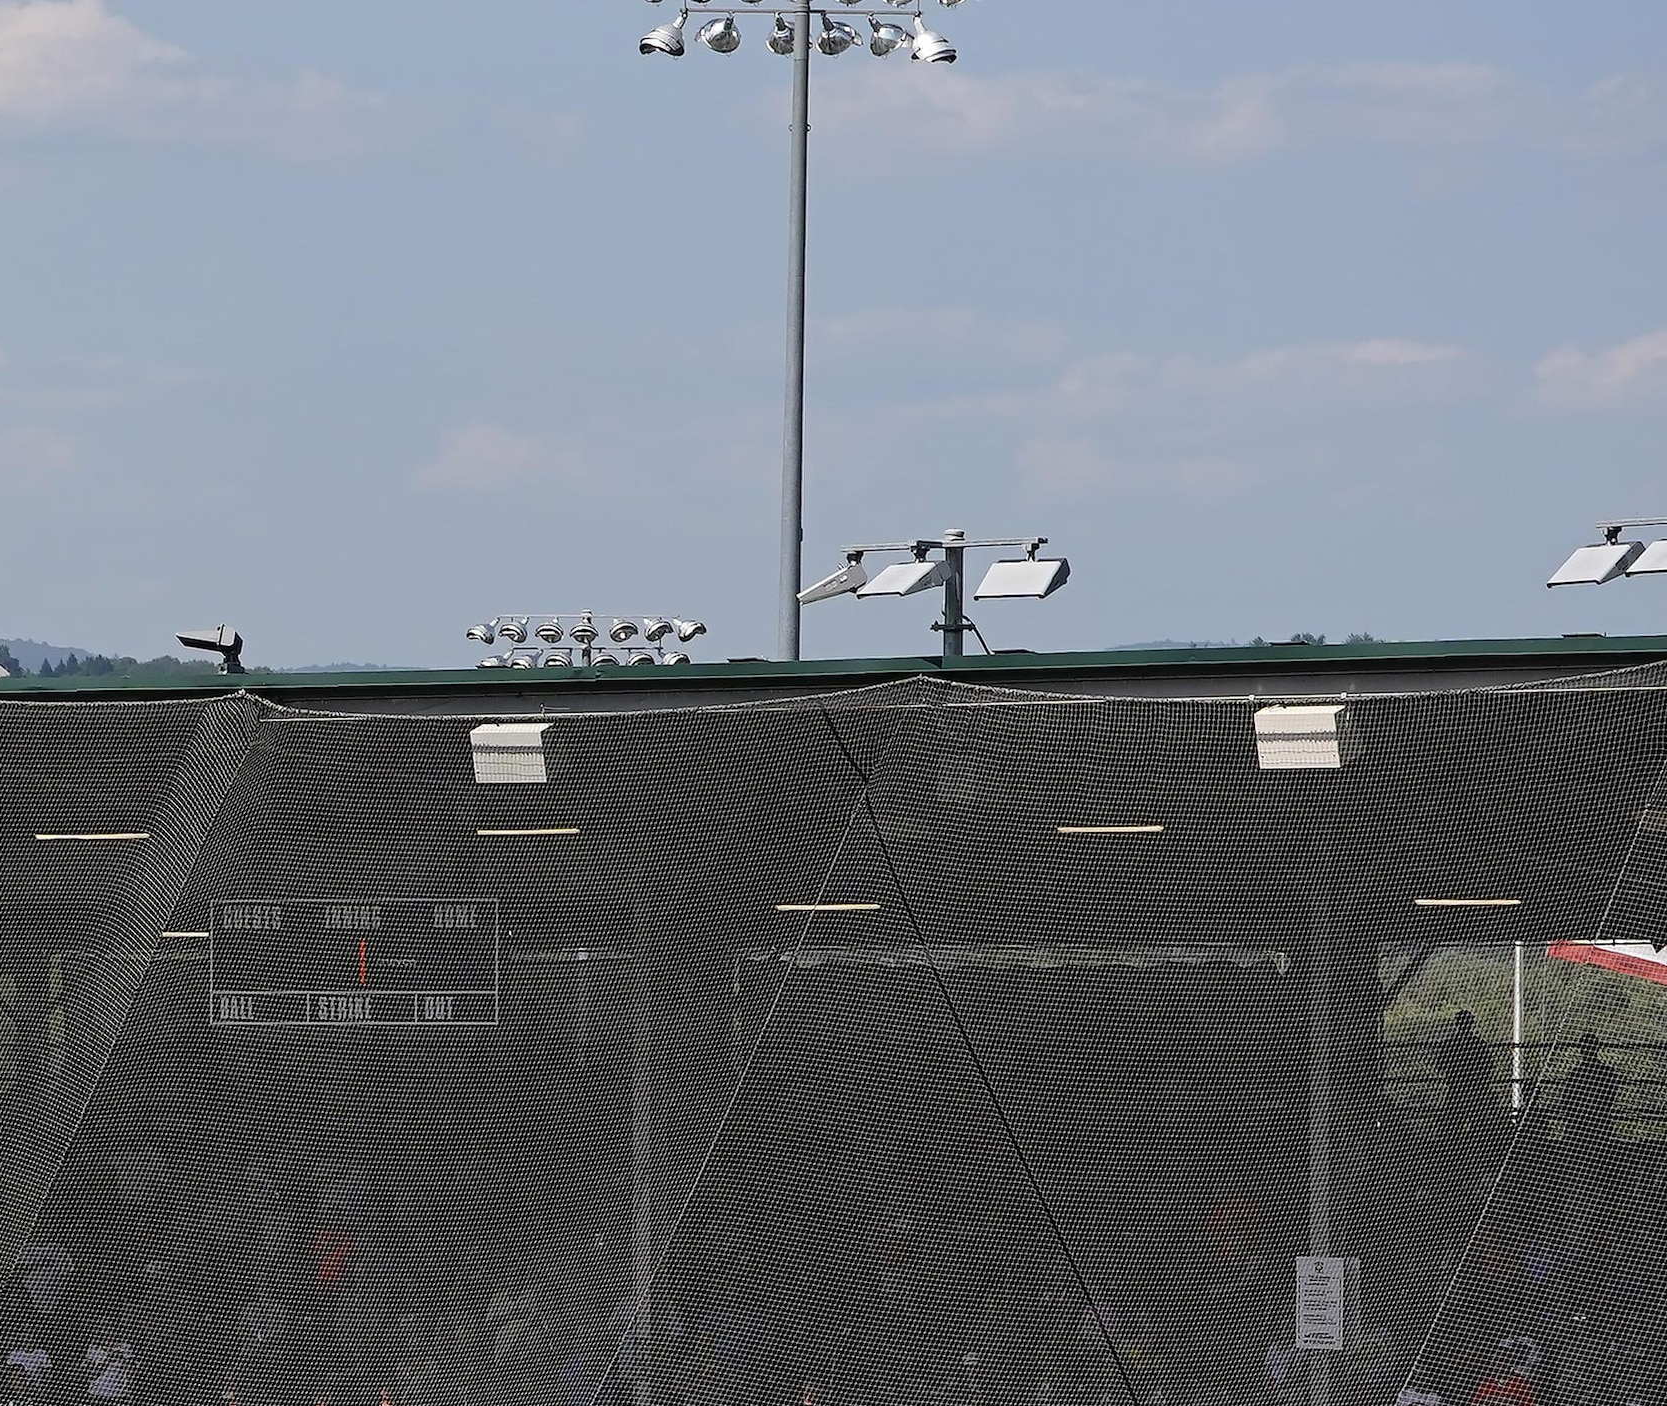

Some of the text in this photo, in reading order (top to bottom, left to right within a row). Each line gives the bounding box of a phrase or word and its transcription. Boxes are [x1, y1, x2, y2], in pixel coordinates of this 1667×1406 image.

[219, 996, 254, 1020] BALL
[317, 996, 372, 1020] STRIKE
[423, 996, 454, 1019] OUT
